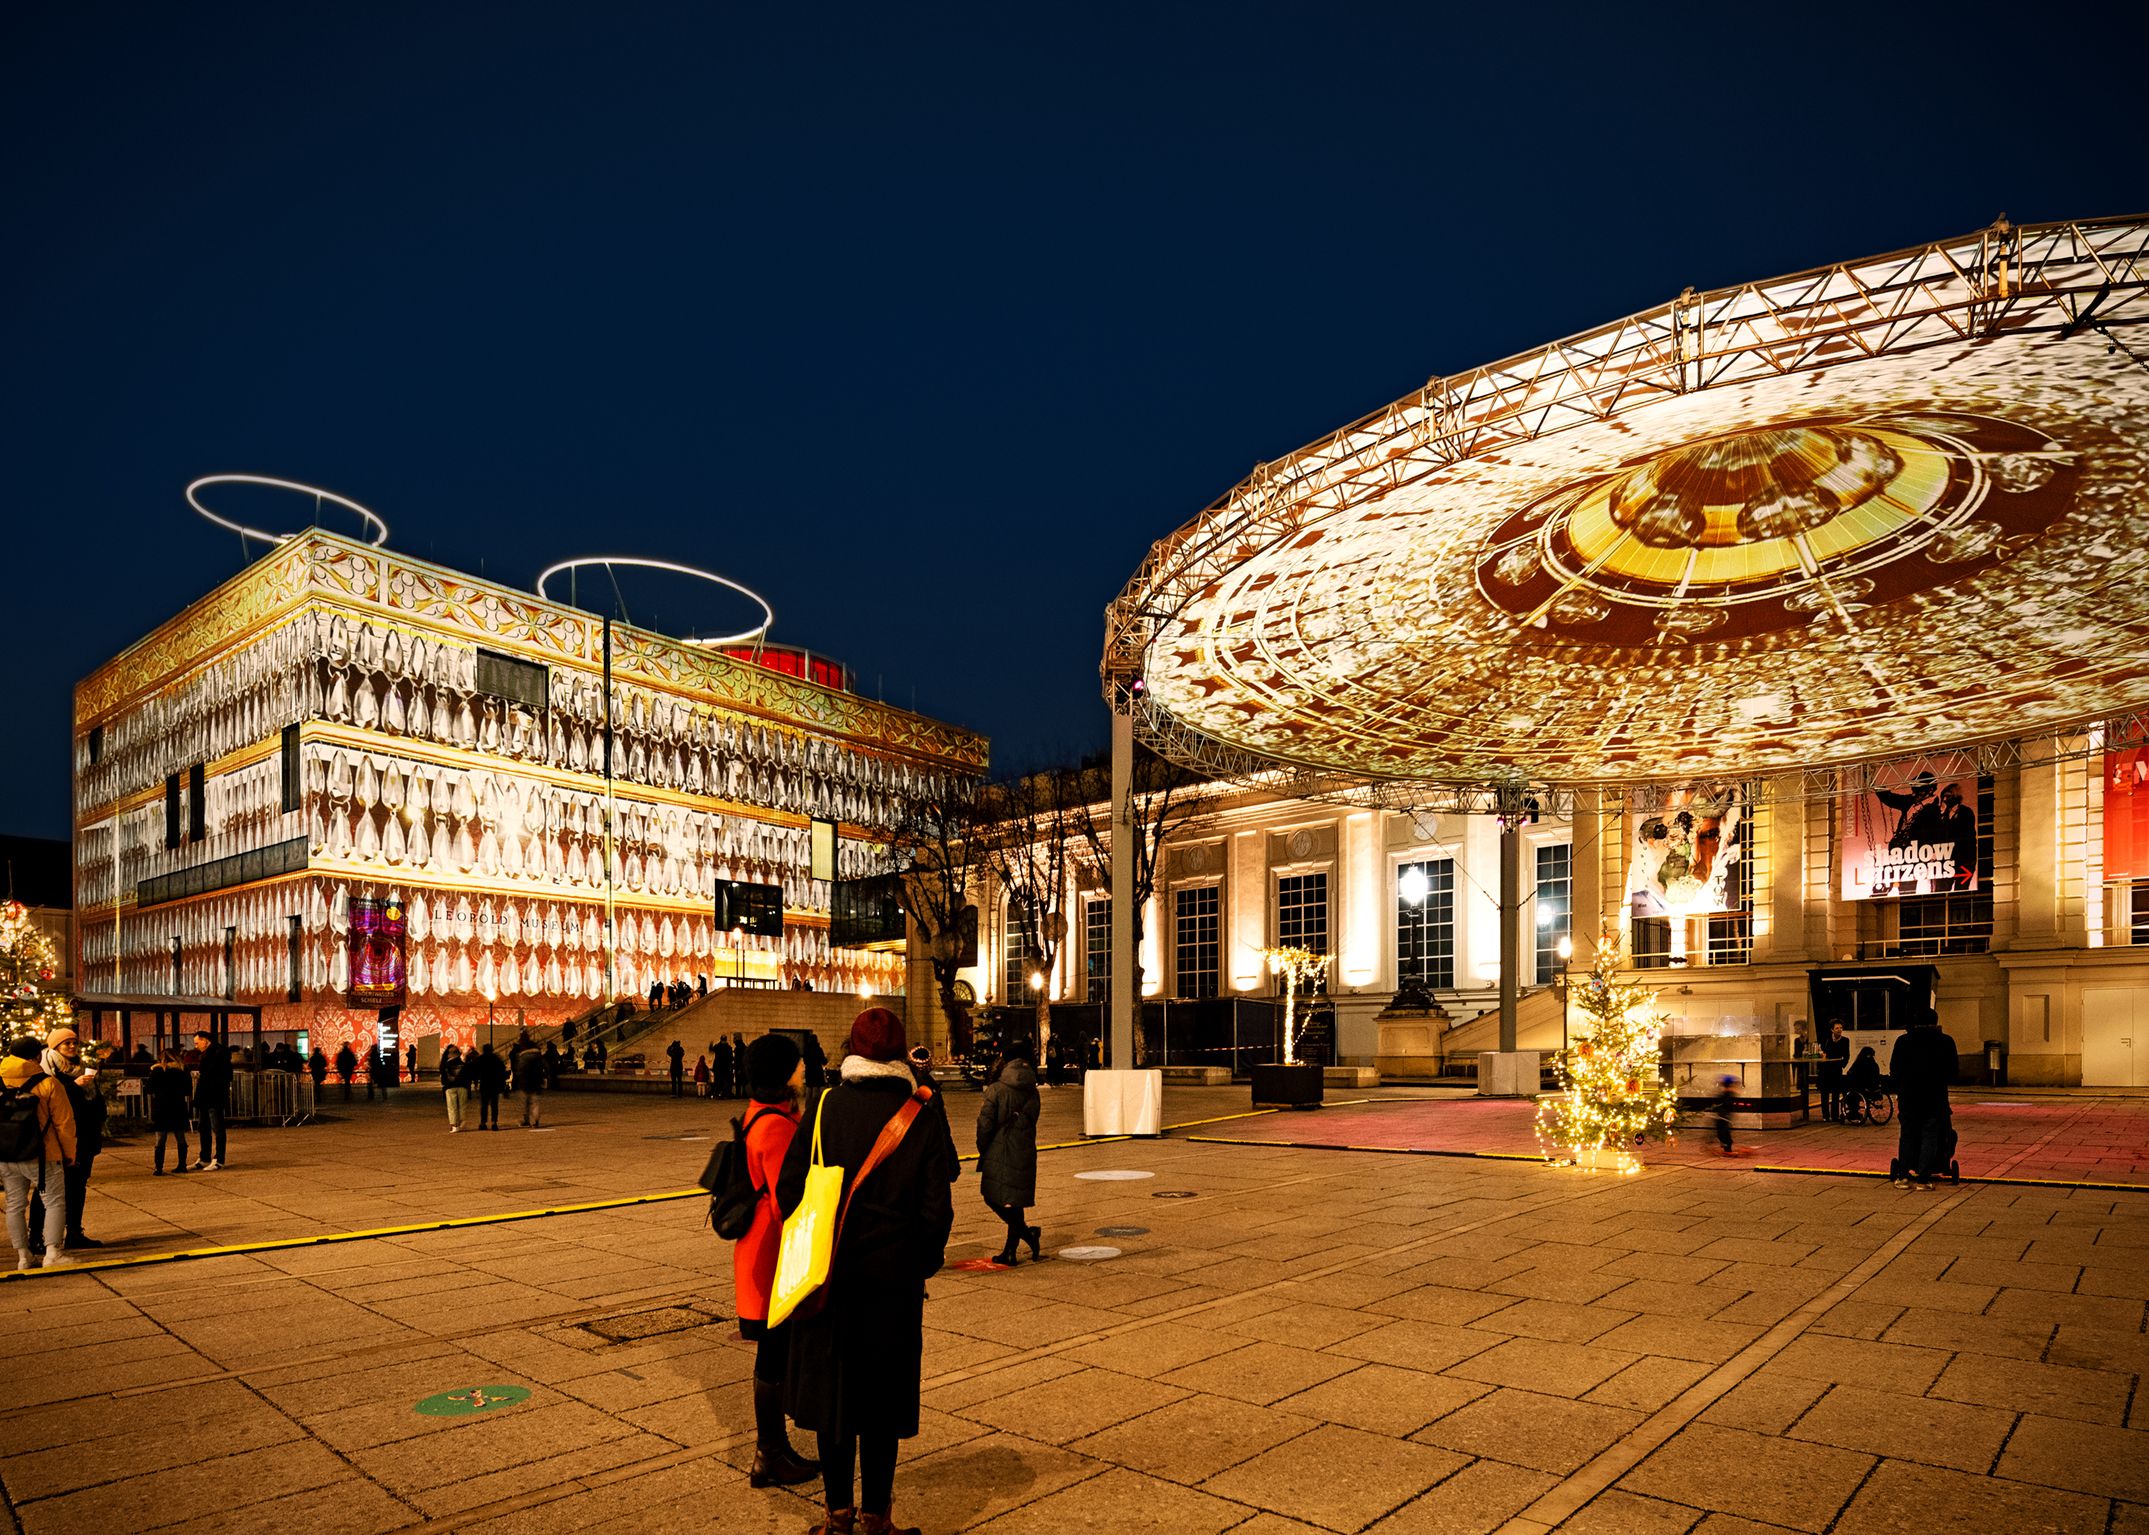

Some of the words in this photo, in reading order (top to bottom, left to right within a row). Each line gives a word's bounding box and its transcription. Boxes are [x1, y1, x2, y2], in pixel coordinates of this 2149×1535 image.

[1864, 840, 1955, 867] shadow
[434, 909, 509, 925] LEOPOLD
[520, 916, 580, 932] MUSEUM
